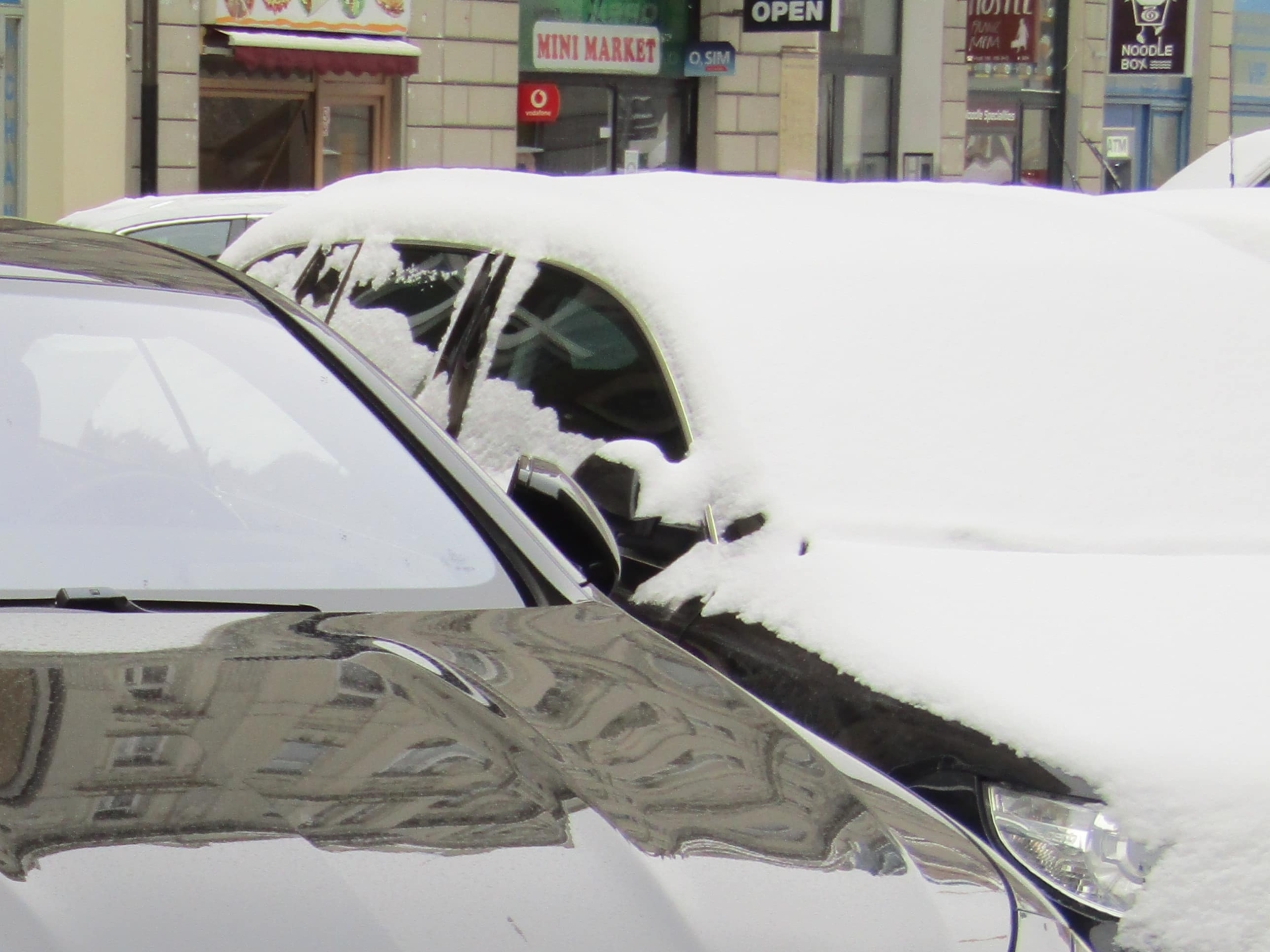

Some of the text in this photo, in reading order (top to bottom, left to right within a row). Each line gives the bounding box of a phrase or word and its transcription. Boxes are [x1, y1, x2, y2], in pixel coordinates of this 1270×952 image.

[752, 0, 823, 22] OPEN
[537, 33, 656, 63] MINI MARKET
[1121, 37, 1173, 56] NOODLE
[705, 50, 730, 65] SIM
[1121, 58, 1148, 70] BOX
[1107, 138, 1127, 154] ATM
